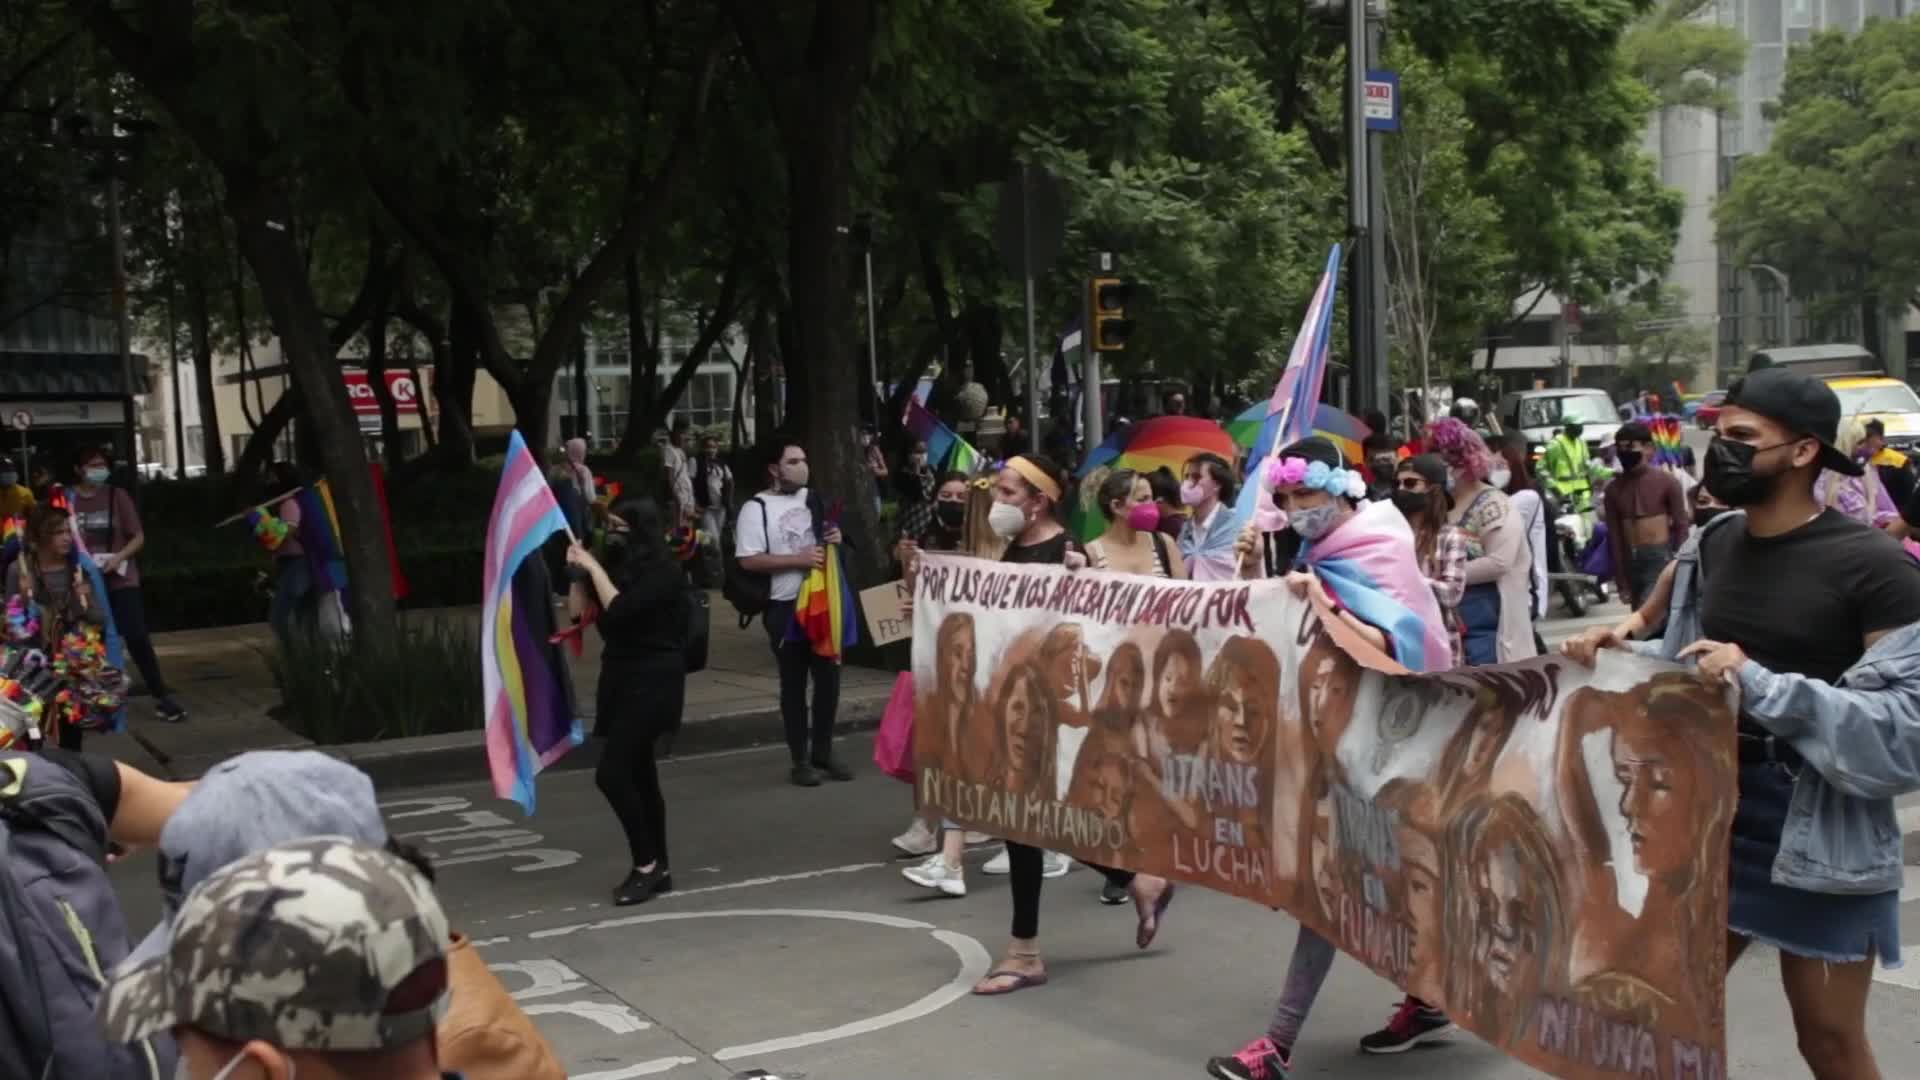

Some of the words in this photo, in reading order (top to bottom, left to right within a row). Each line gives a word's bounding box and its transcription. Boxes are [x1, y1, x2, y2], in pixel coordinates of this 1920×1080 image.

[921, 565, 949, 605] POR
[950, 567, 981, 602] LAS
[979, 572, 1016, 610] QUE
[1013, 574, 1051, 609] NOS
[1201, 585, 1255, 633] POR
[1023, 790, 1125, 850] MATANDO
[1215, 816, 1245, 847] EN
